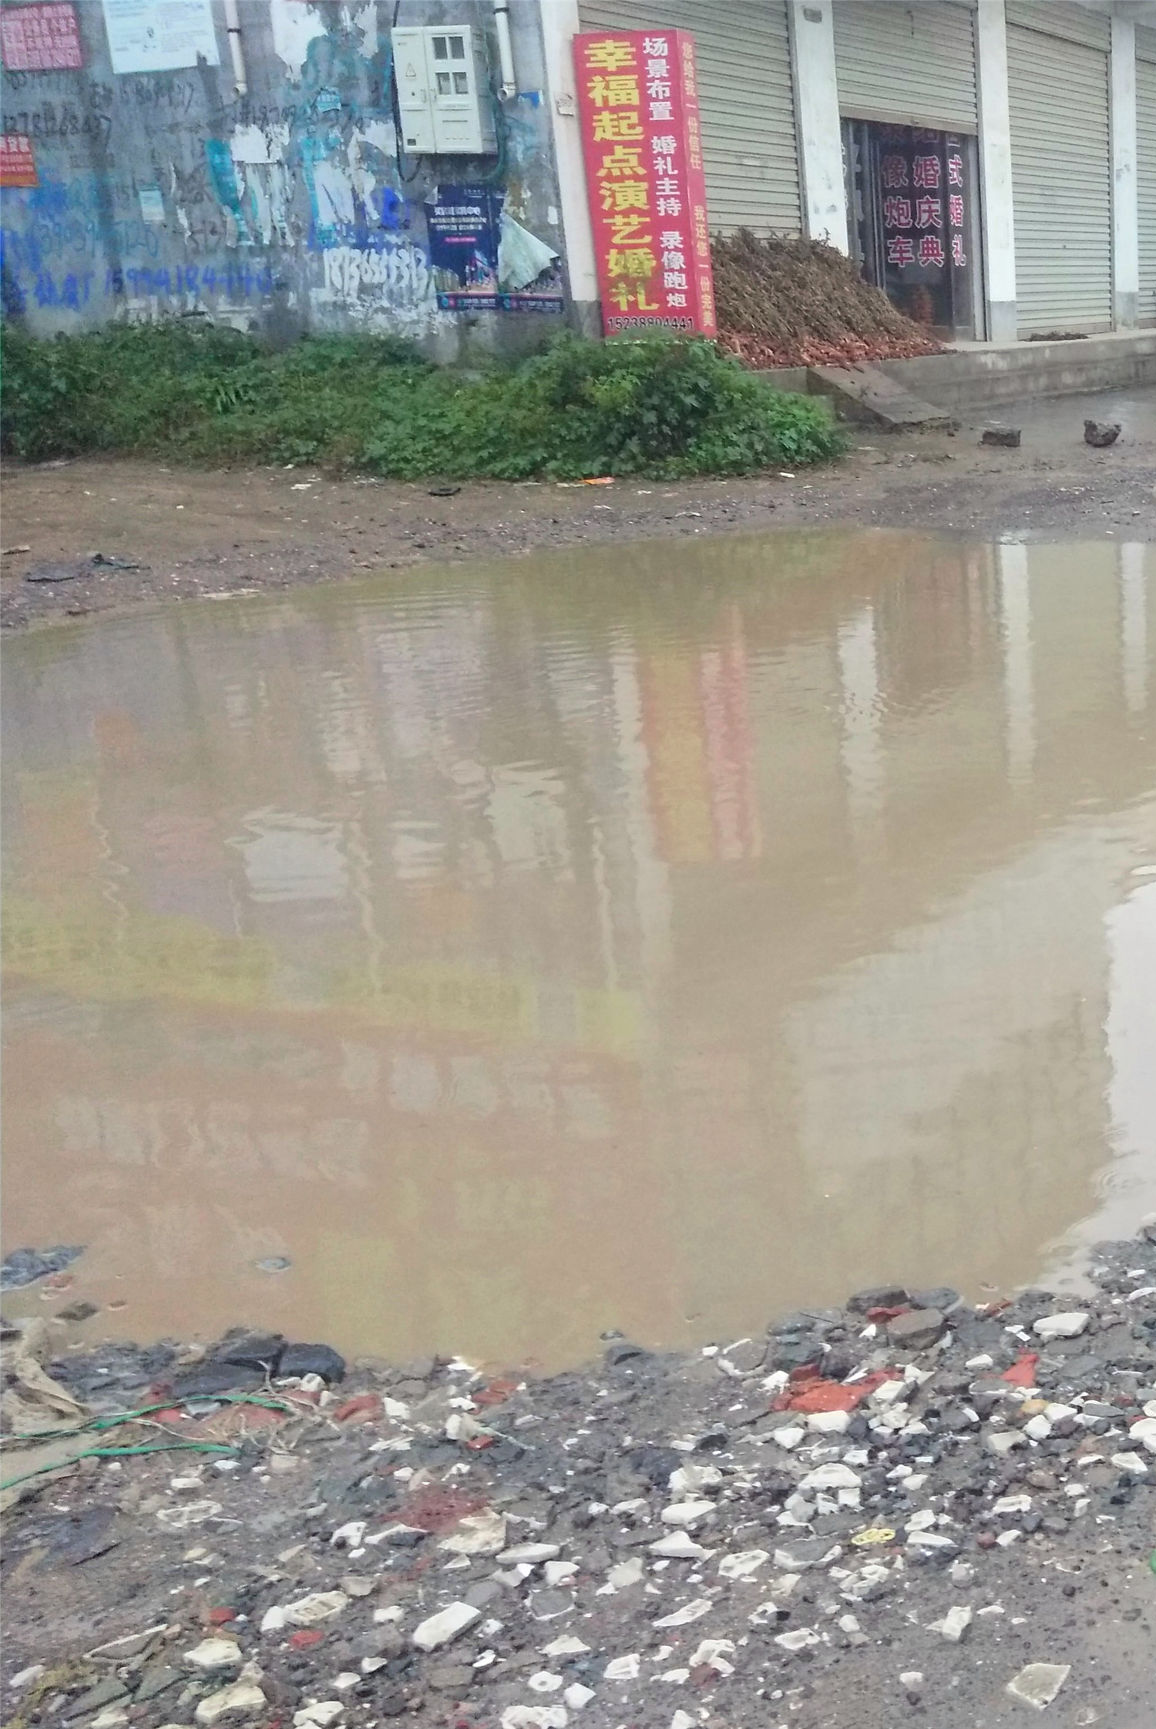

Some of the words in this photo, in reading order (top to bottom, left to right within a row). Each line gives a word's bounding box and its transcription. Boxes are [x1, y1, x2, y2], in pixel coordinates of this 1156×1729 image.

[642, 37, 675, 121] 场景布置
[584, 39, 660, 312] 幸福起点演艺婚礼
[650, 135, 683, 217] 婚礼主持
[659, 231, 689, 308] 录像跑炮
